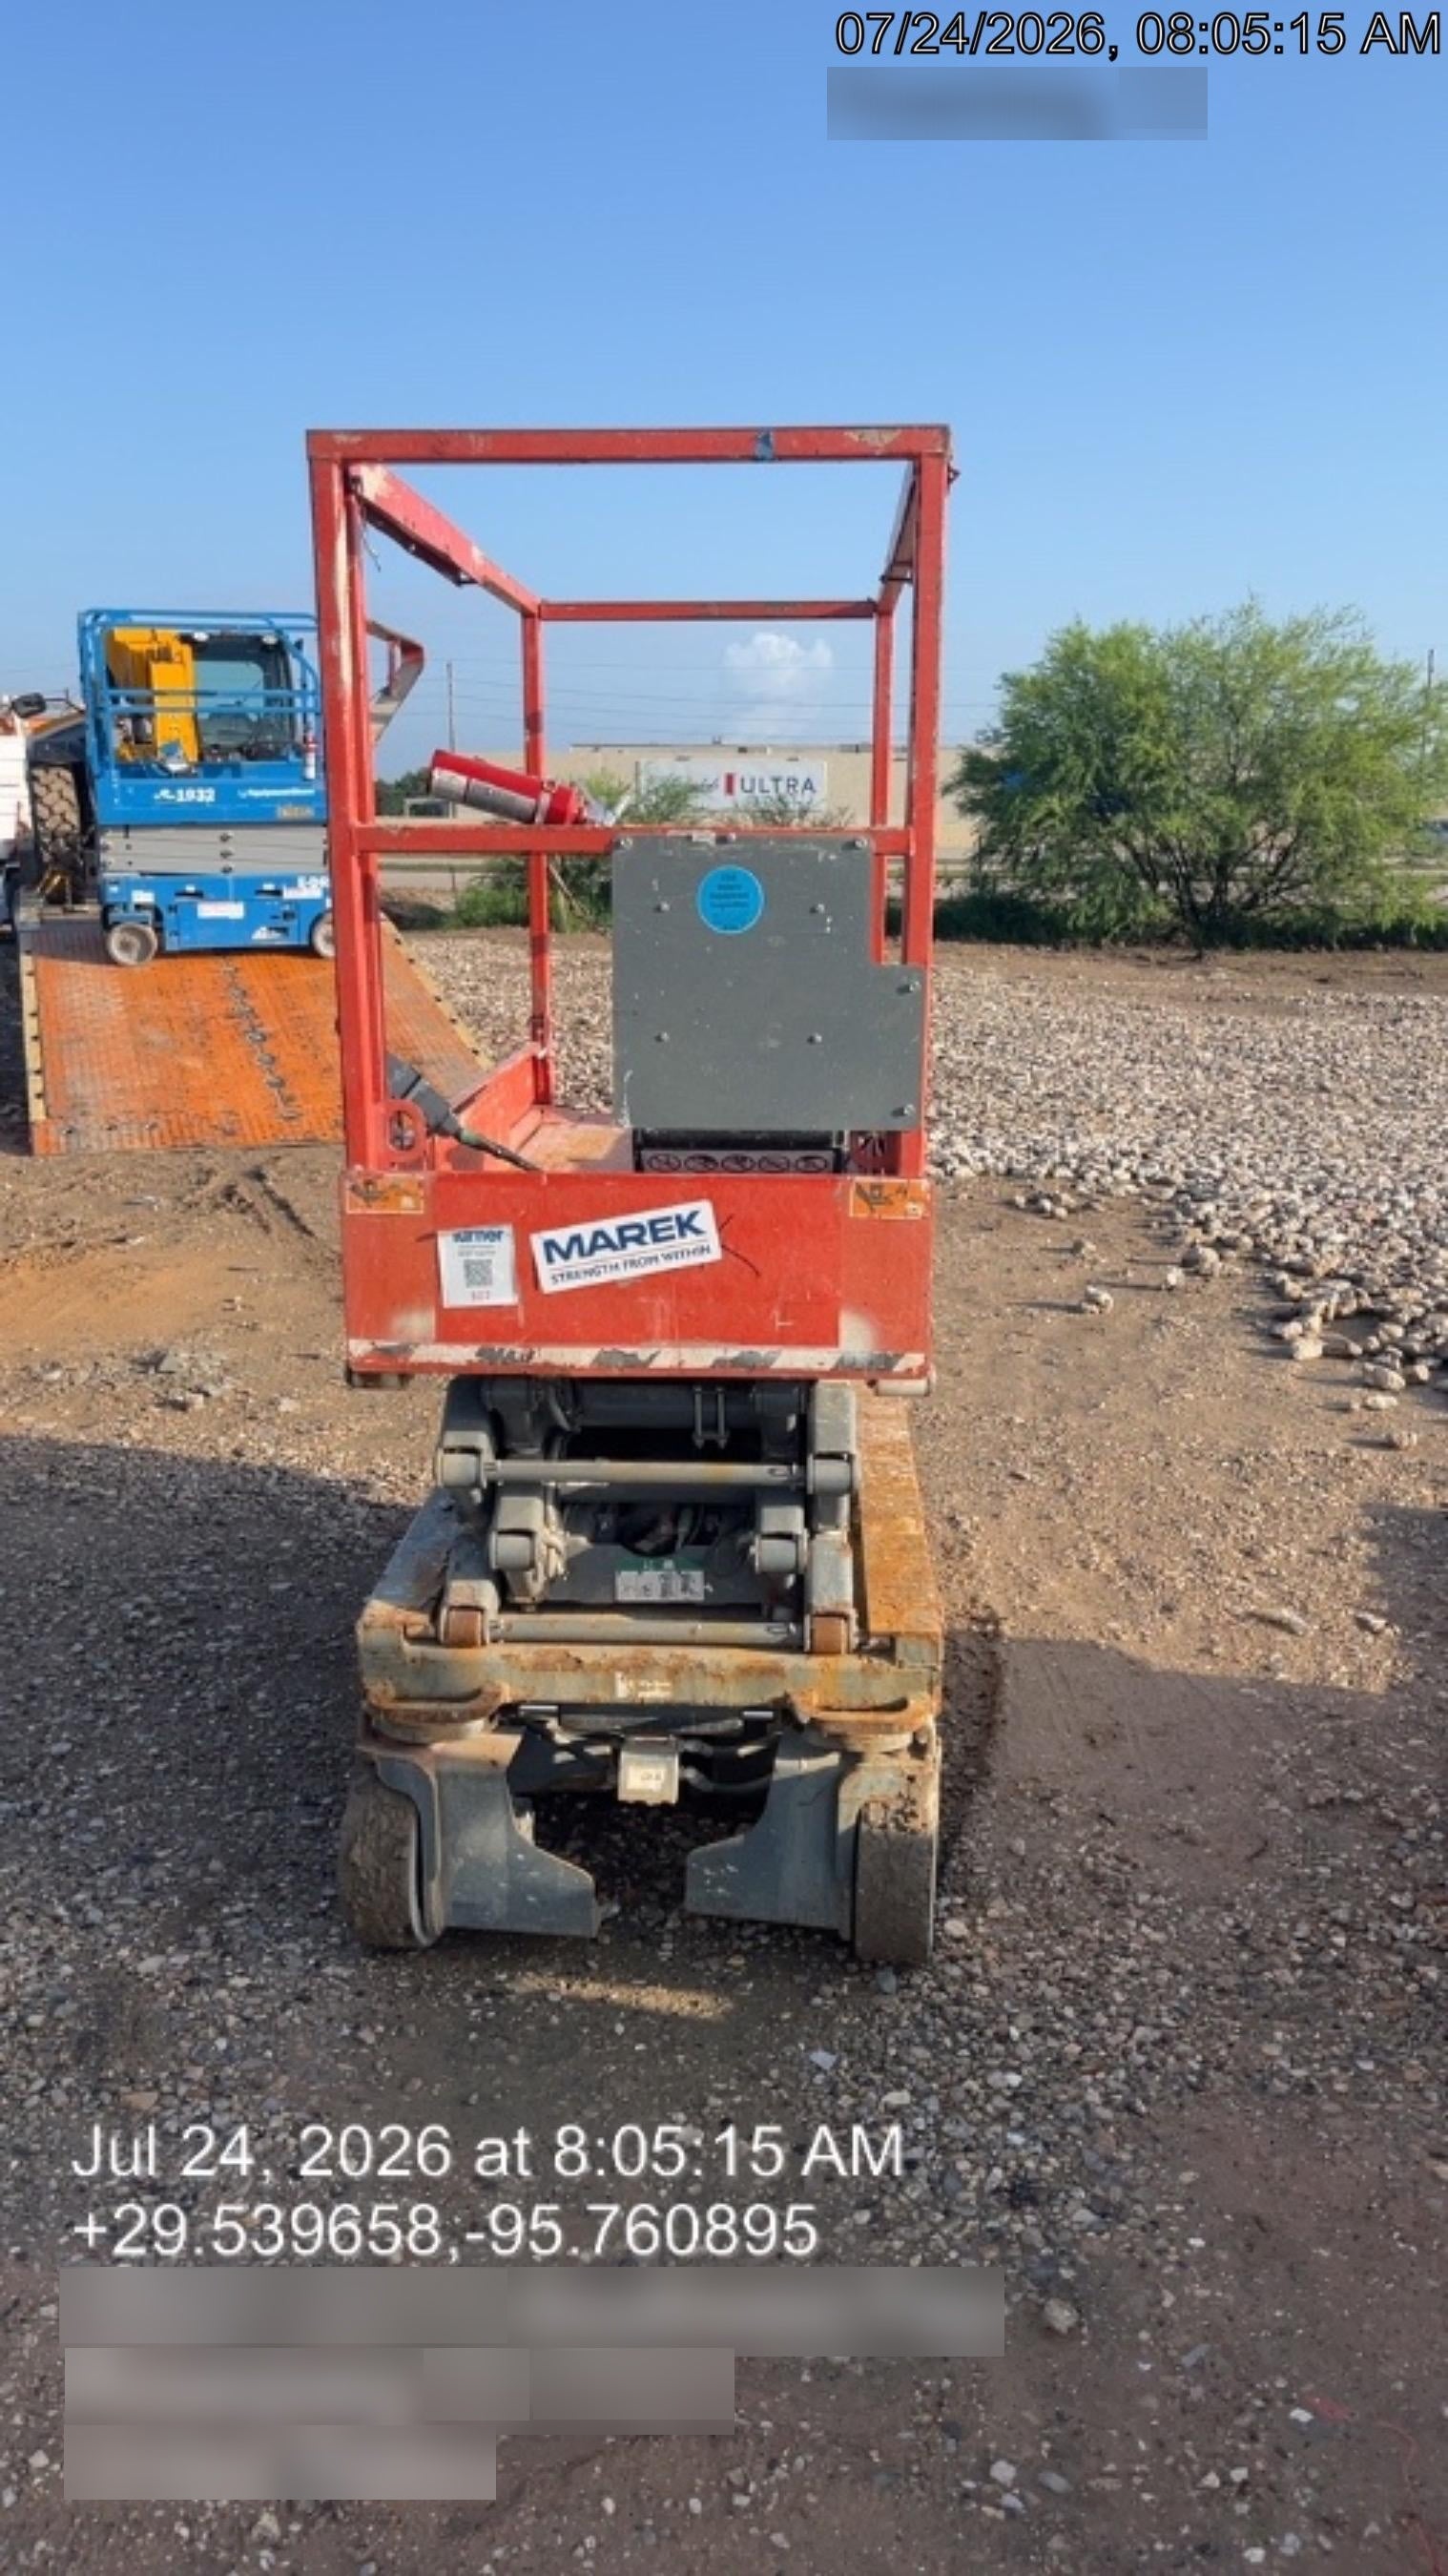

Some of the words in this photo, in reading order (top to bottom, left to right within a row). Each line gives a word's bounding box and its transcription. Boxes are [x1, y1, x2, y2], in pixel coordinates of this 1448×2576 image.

[740, 776, 817, 795] ULTRA
[543, 1210, 706, 1264] MAREK
[550, 1263, 621, 1285] STRENGTH
[623, 1255, 660, 1275] FROM
[660, 1244, 712, 1265] WITHIN
